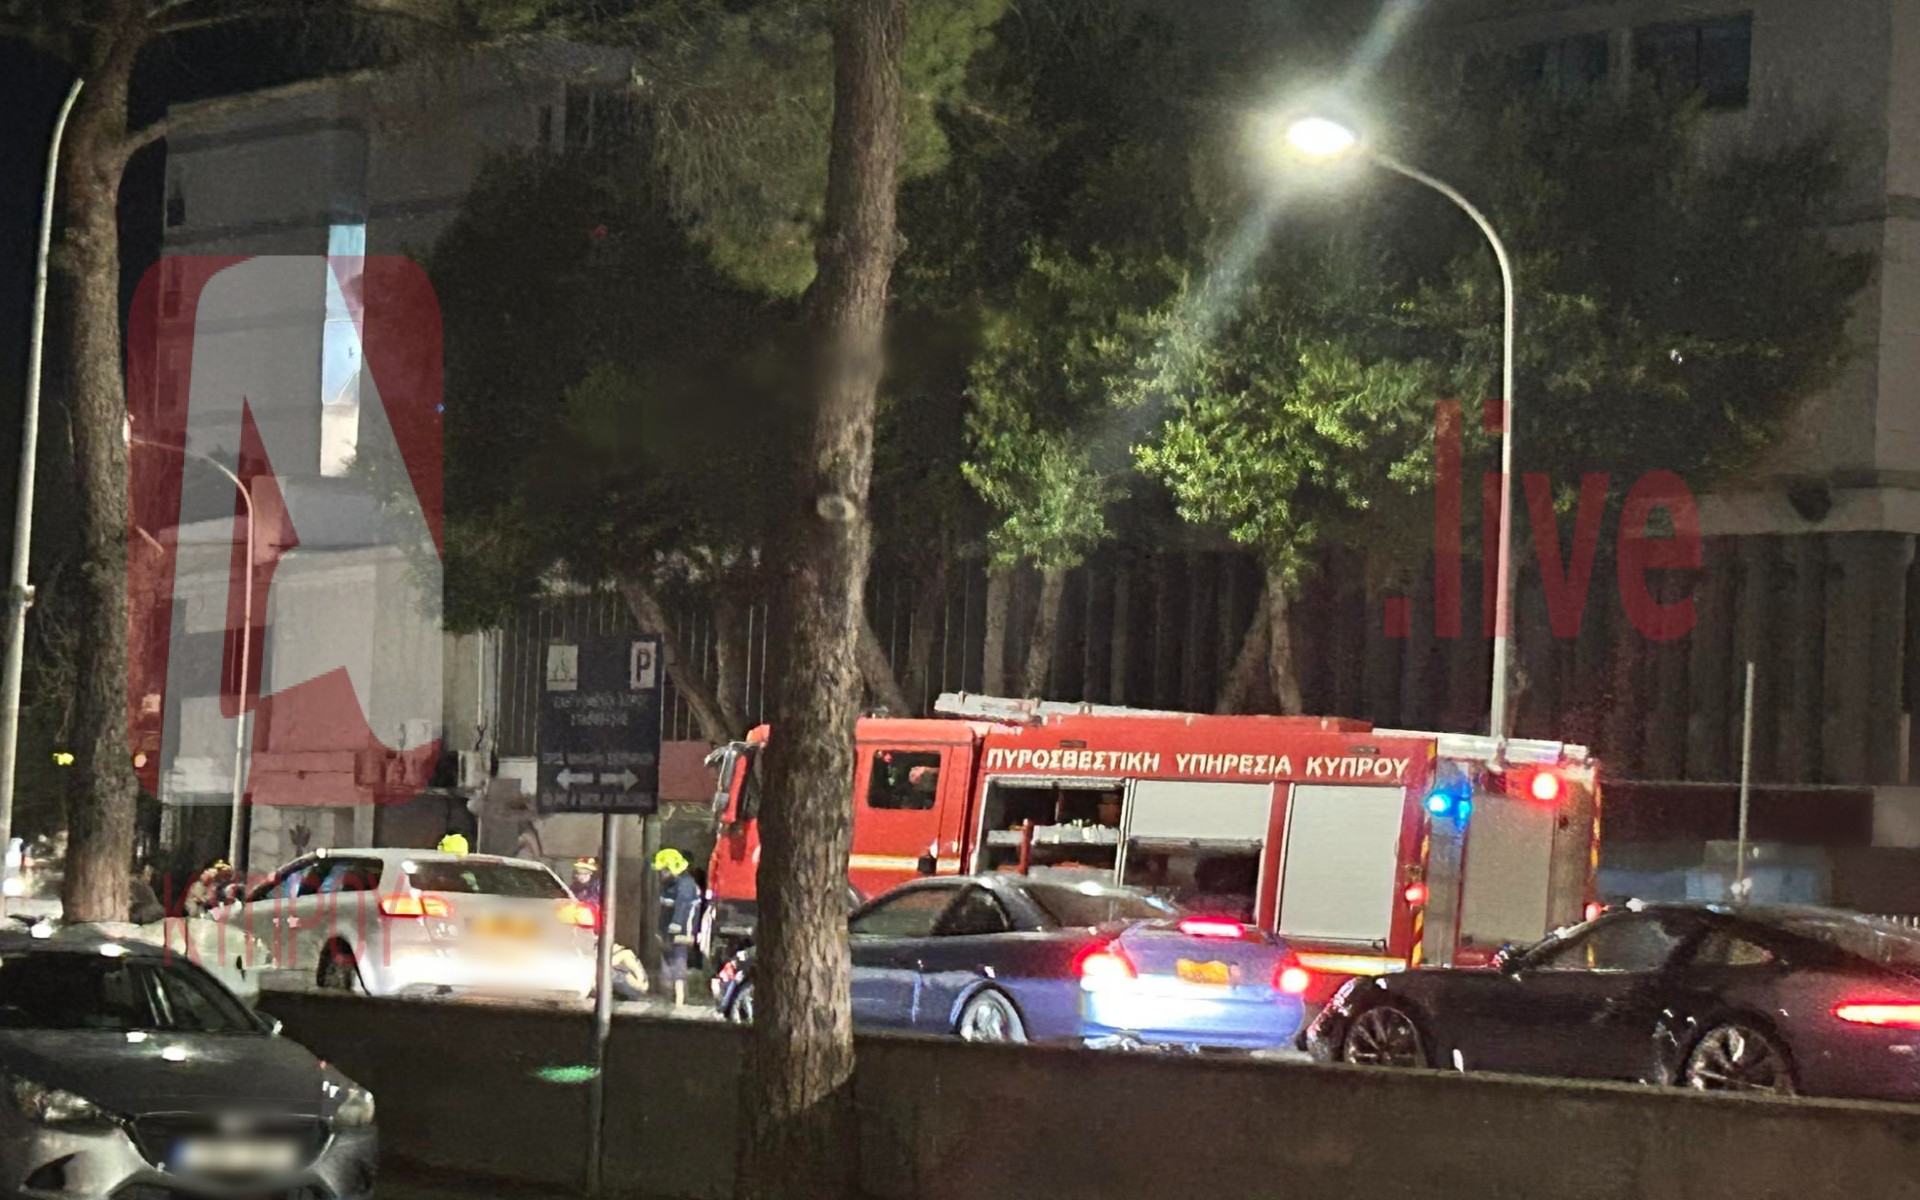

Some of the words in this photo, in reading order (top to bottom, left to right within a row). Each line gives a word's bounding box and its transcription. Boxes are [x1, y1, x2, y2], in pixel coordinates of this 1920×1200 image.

[636, 650, 650, 683] P
[986, 747, 1160, 773] ΠΥΡΟΣΒΕΣΤΙΚΗ
[1175, 752, 1292, 776] ΥΠΗΡΕΣΙΑ
[1304, 755, 1410, 779] ΚΥΠΡΟΥ
